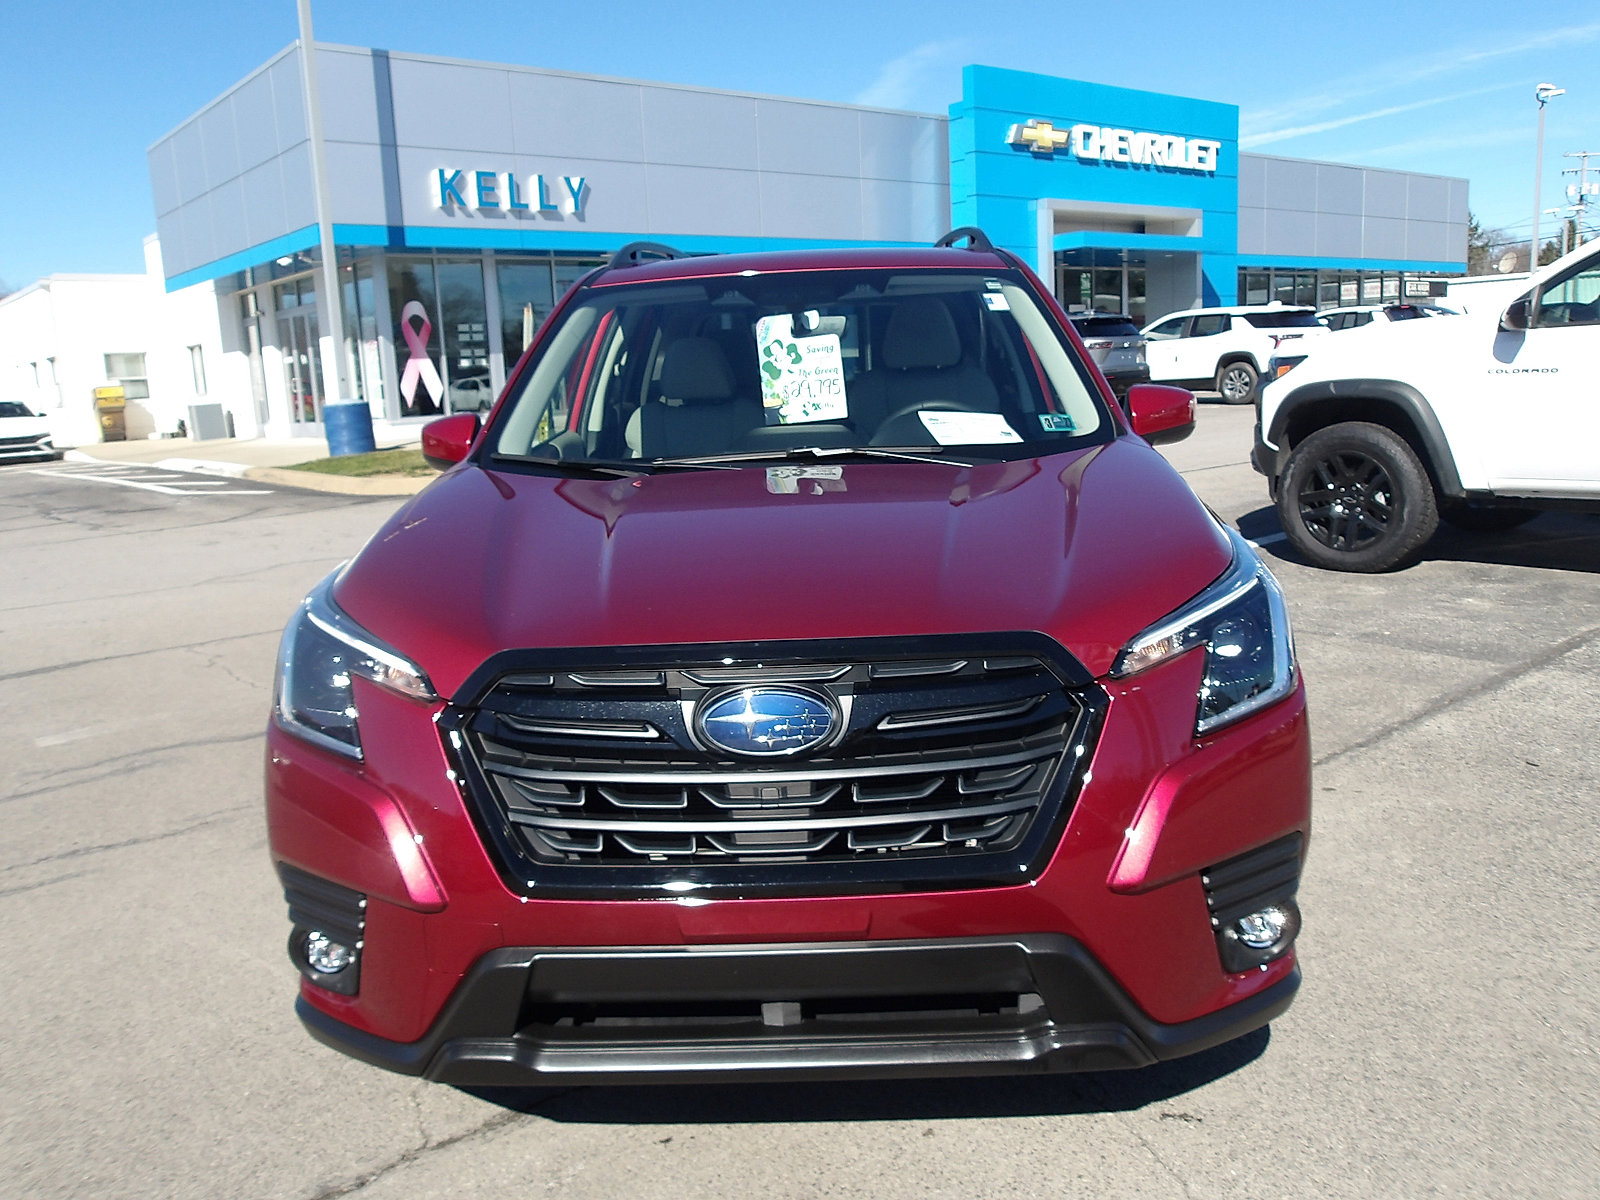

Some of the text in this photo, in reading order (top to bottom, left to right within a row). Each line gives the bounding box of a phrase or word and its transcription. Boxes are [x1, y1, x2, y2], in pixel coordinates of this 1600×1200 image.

[1072, 124, 1221, 172] CHEVROLET
[433, 168, 586, 212] KELLY
[806, 344, 834, 355] Saving
